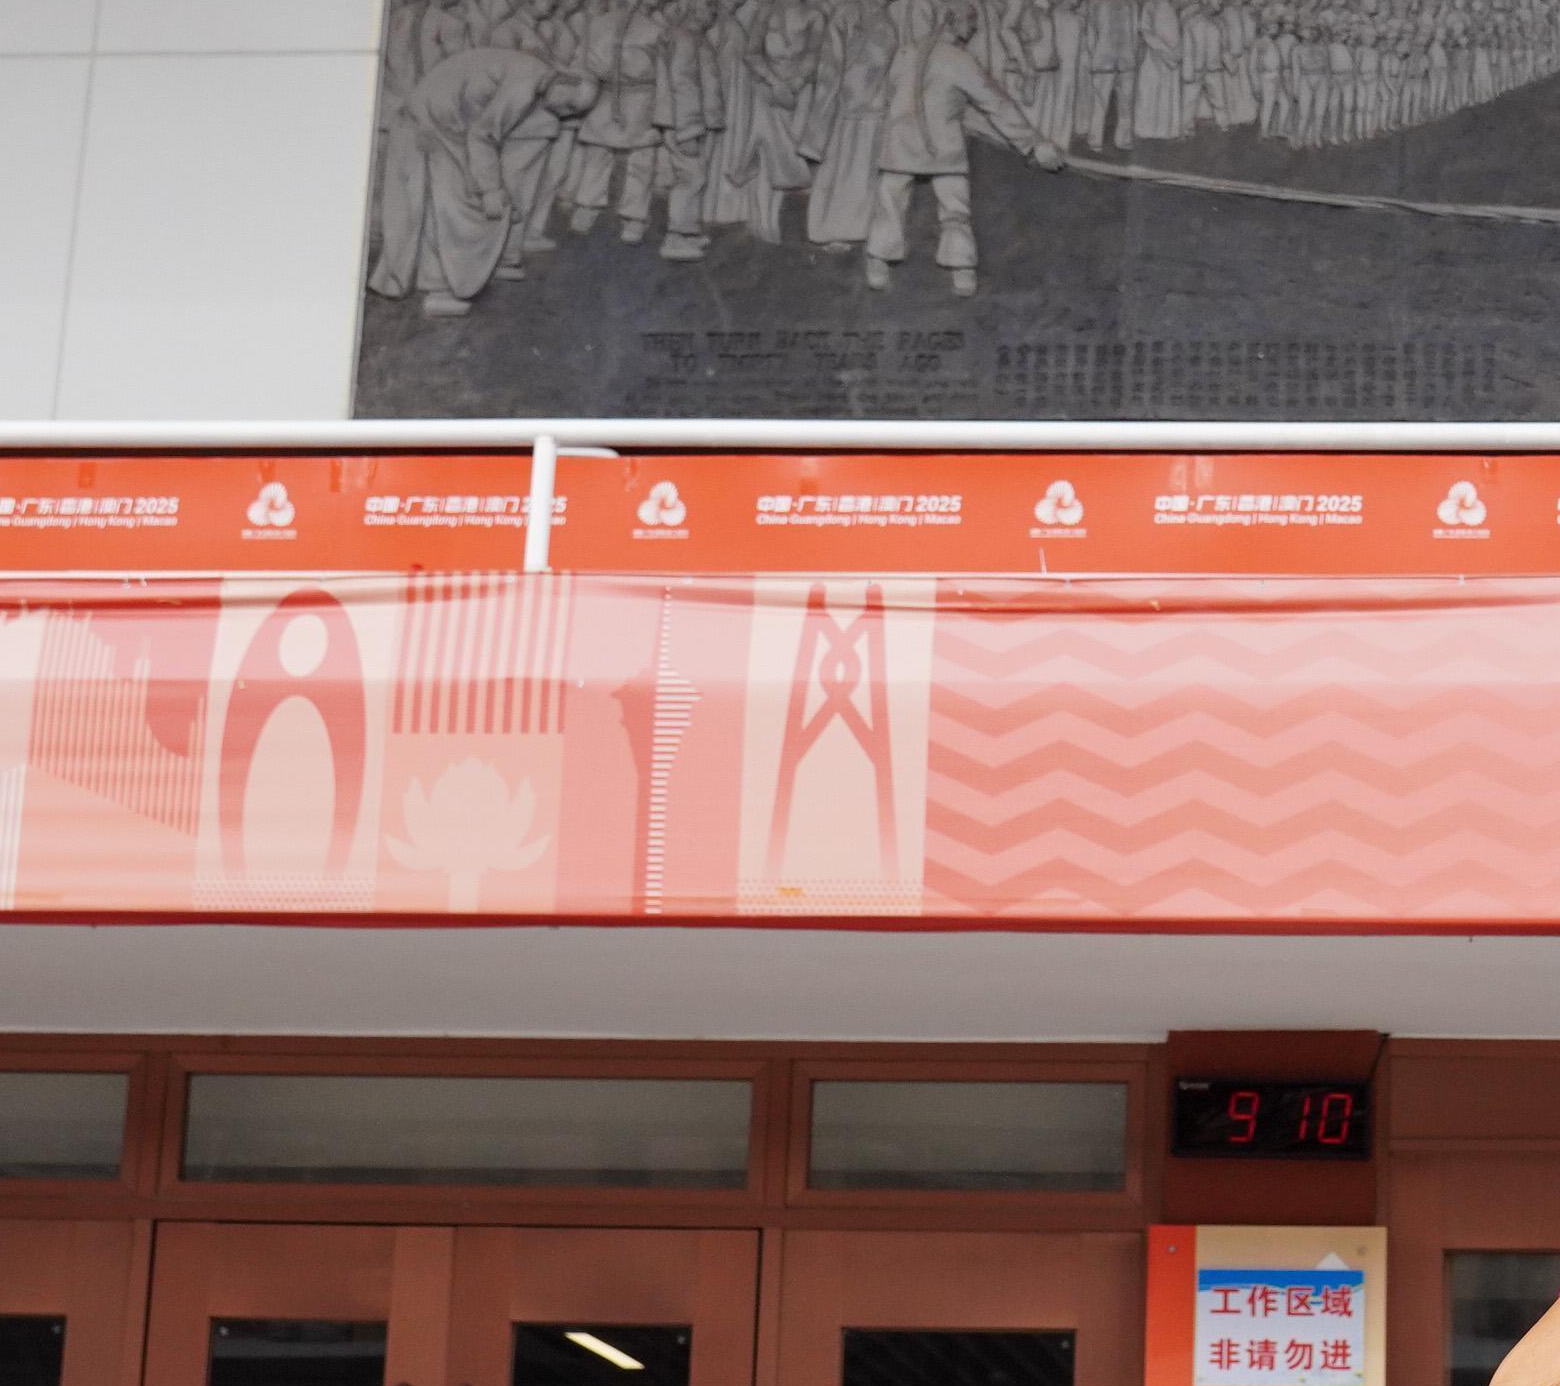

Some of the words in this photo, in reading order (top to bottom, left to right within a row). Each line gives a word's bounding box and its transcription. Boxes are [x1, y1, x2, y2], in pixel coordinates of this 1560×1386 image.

[137, 497, 179, 515] 2025
[917, 495, 961, 512] 2025
[1318, 495, 1362, 512] 2025
[1259, 514, 1286, 525] Hong
[1290, 514, 1317, 526] Kong
[1327, 514, 1362, 524] Macao
[1227, 1090, 1260, 1143] 9
[1298, 1092, 1353, 1145] 10
[1210, 1285, 1353, 1318] 工作区域
[1209, 1338, 1352, 1371] 非请勿进
